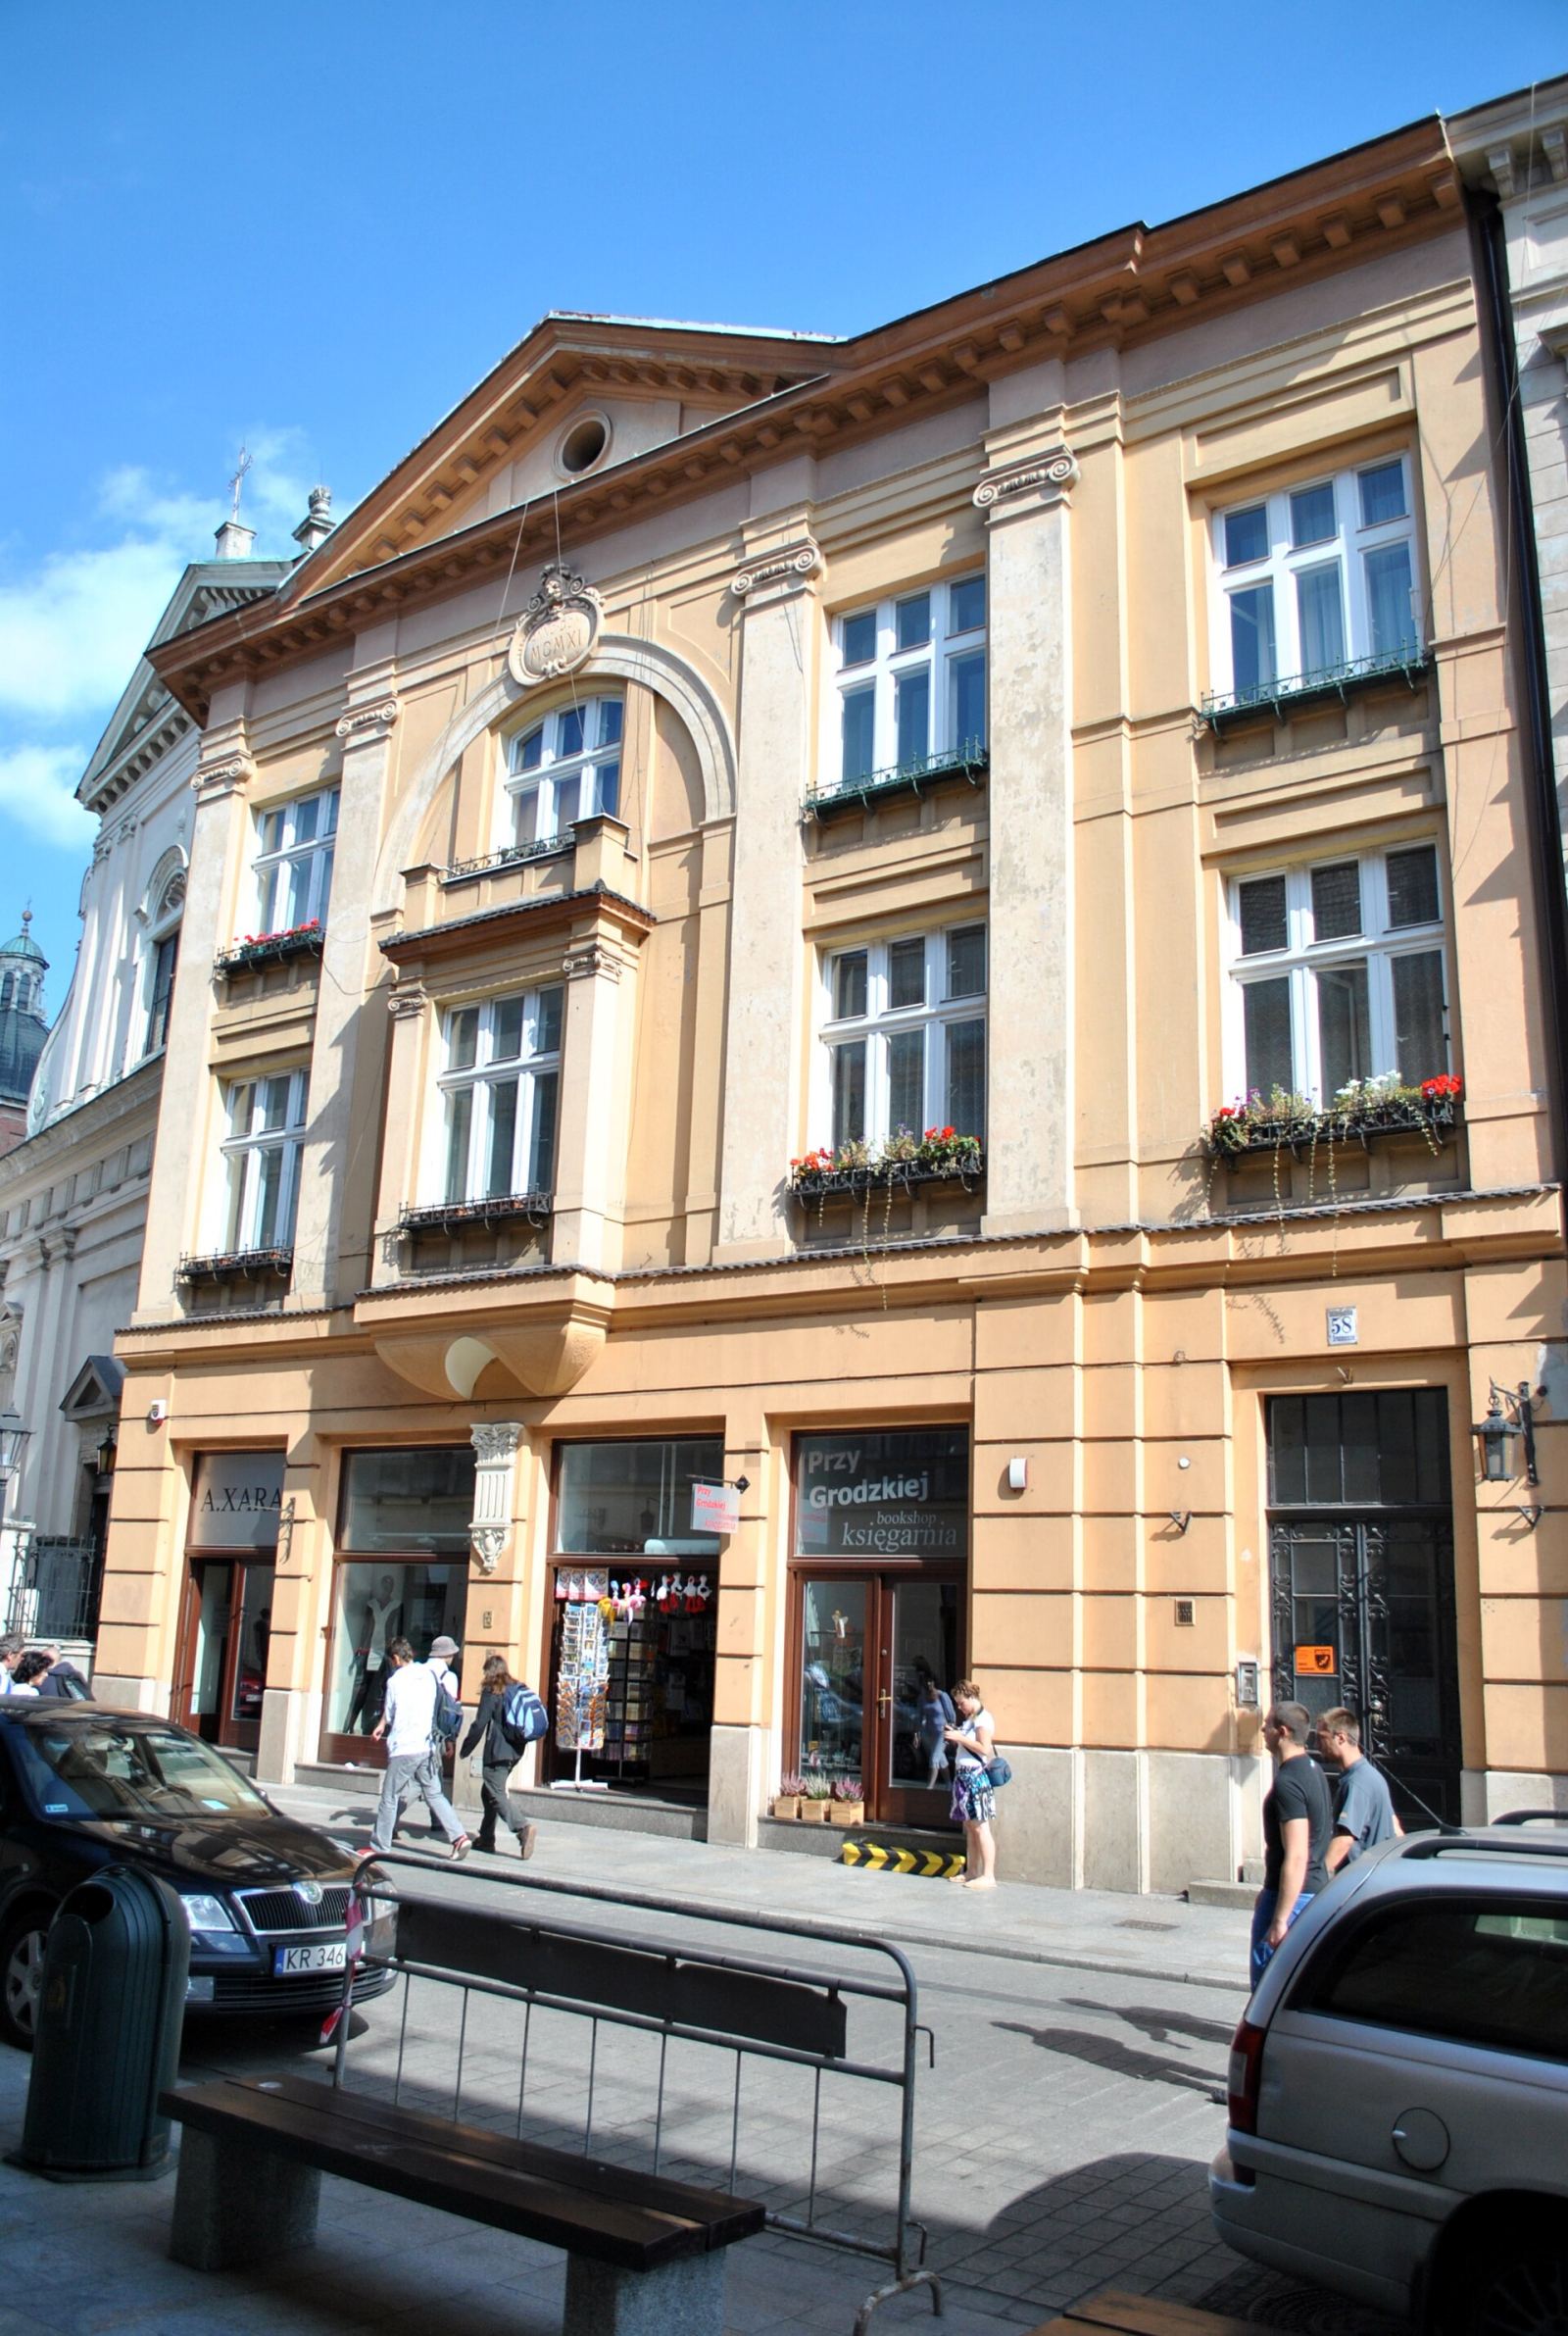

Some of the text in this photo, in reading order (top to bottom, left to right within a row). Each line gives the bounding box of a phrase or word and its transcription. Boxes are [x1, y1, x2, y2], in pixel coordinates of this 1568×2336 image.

[1332, 1317, 1352, 1334] 58
[808, 1450, 860, 1473] Przy
[201, 1487, 281, 1512] A.XARA
[809, 1471, 928, 1509] Grodzkiej
[877, 1511, 937, 1526] bookshop
[841, 1520, 957, 1553] księgarnia
[286, 1945, 344, 1970] KR 346
